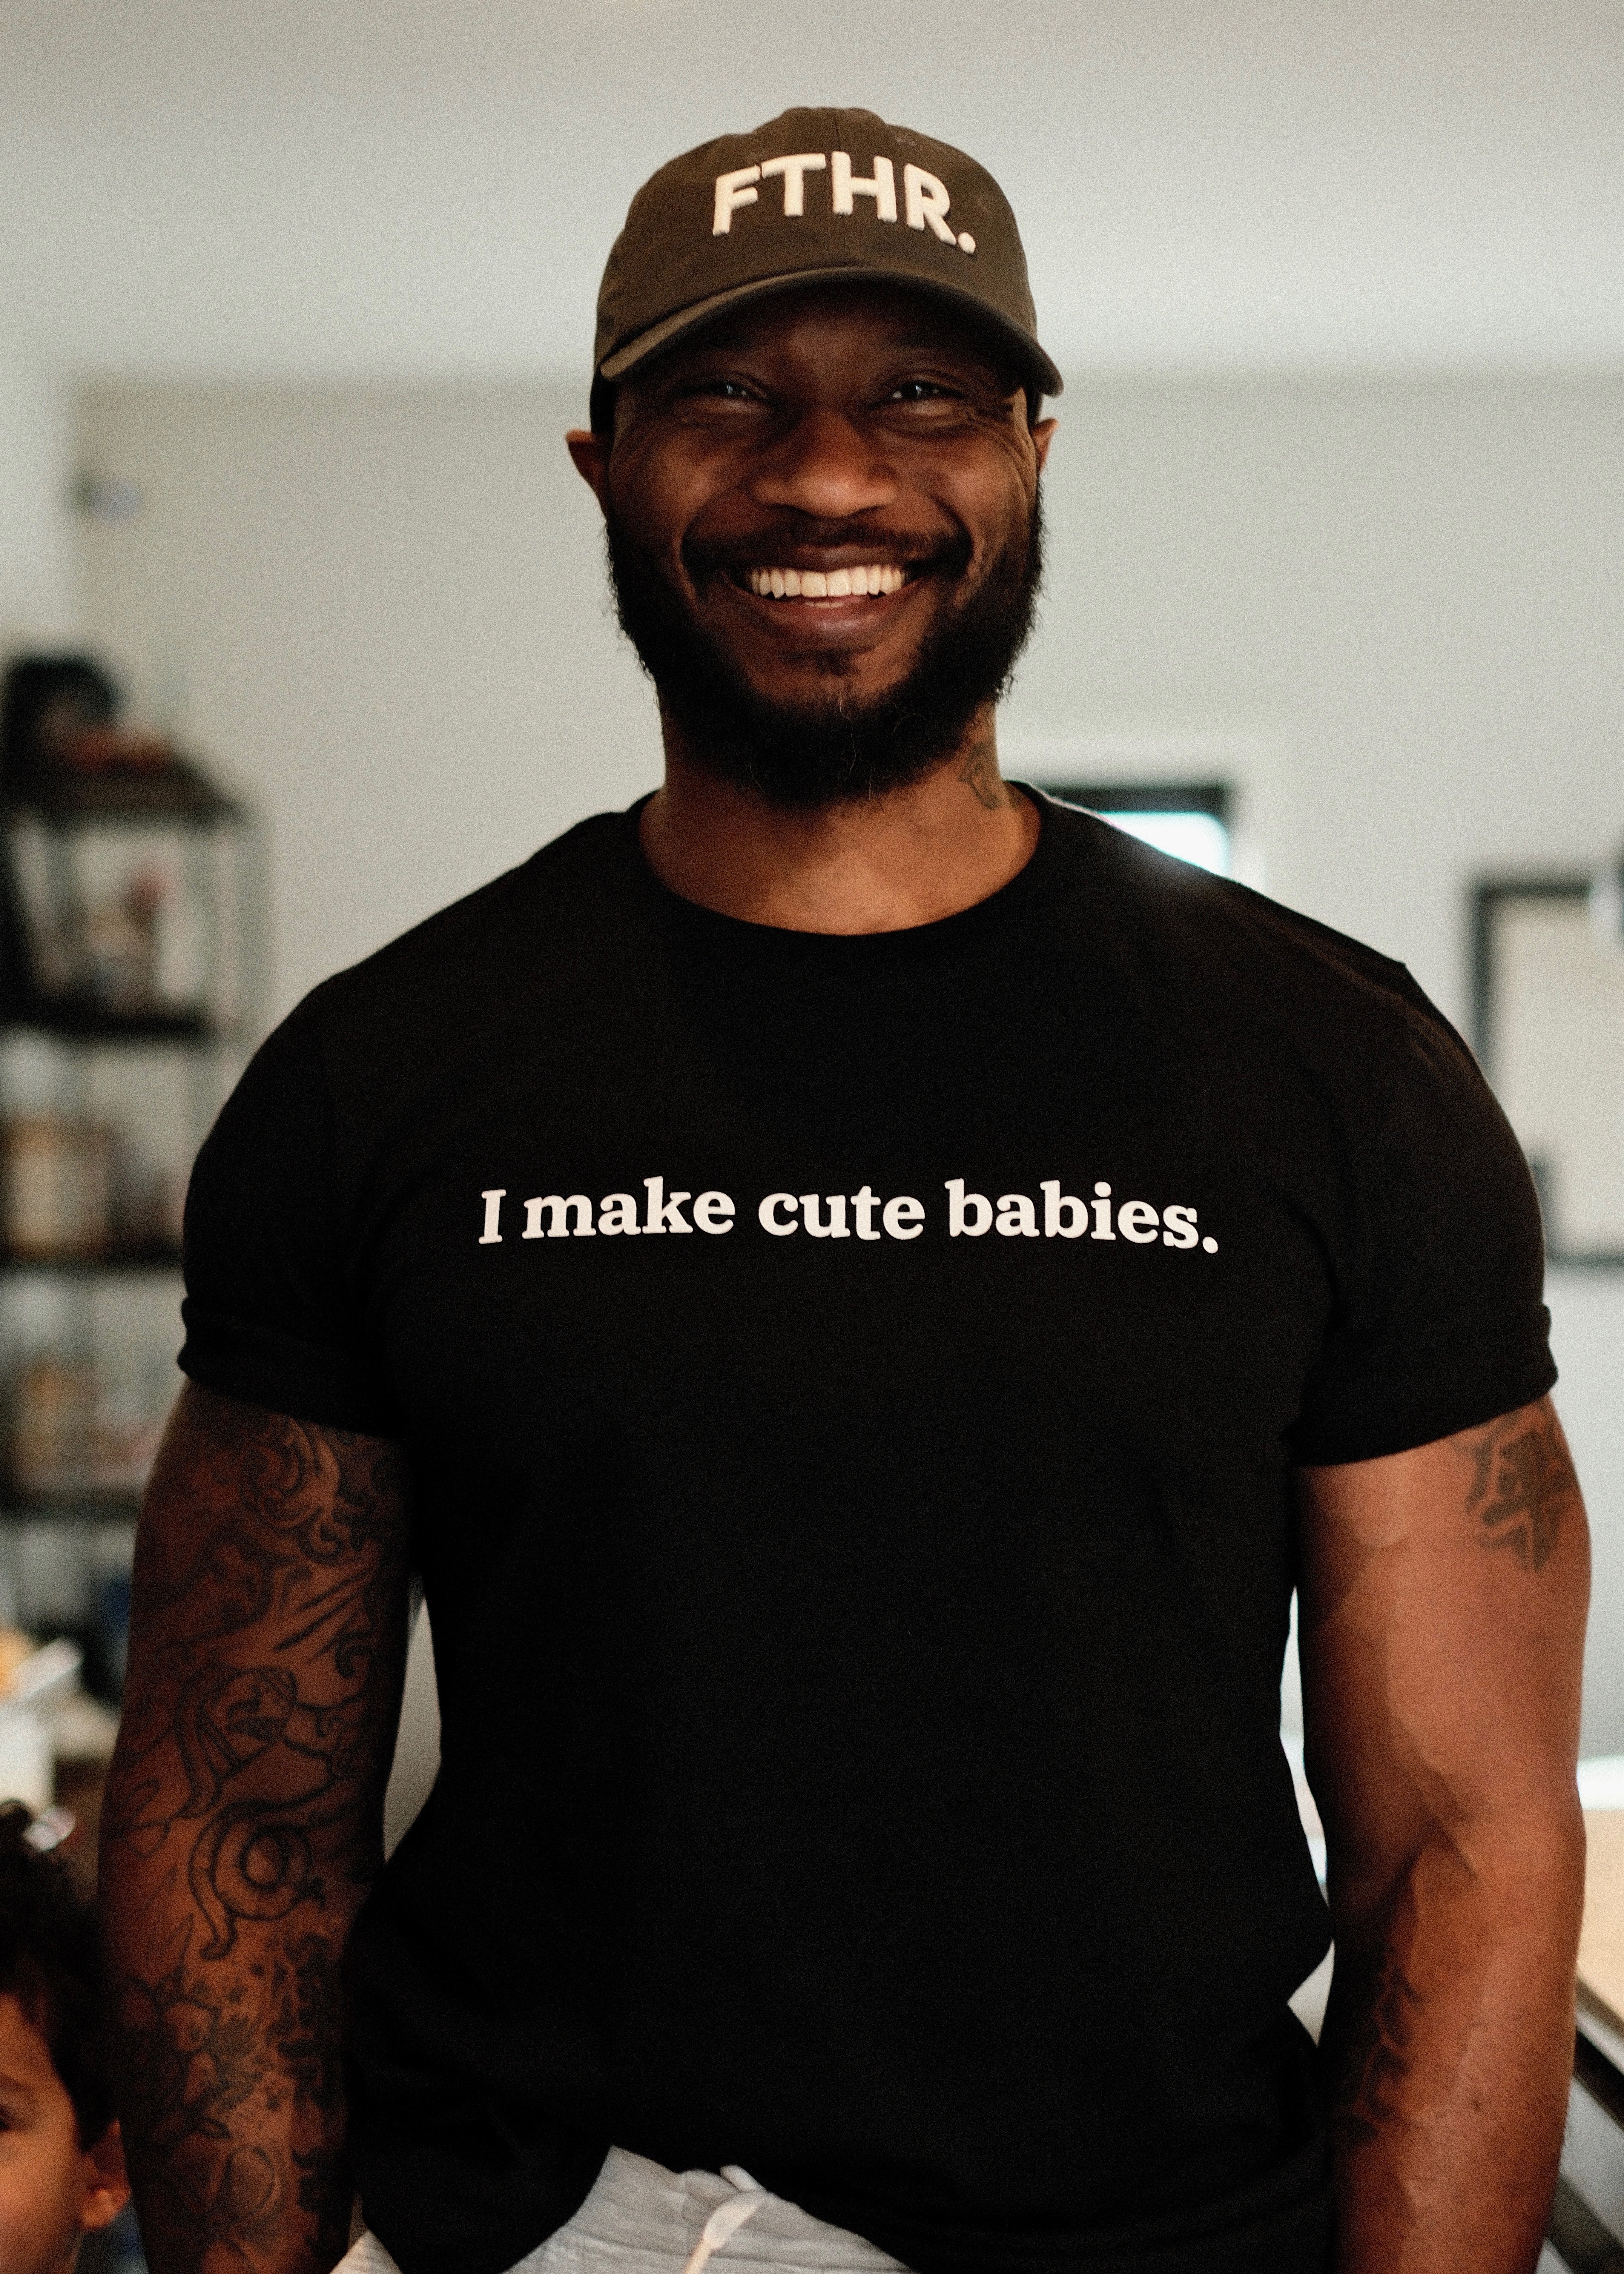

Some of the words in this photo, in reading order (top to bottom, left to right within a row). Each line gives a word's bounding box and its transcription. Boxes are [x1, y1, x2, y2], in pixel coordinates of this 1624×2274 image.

[711, 151, 977, 253] FTHR.
[478, 1189, 507, 1245] I
[522, 1176, 735, 1239] make
[758, 1185, 926, 1241] cute
[944, 1178, 1219, 1254] babies.
